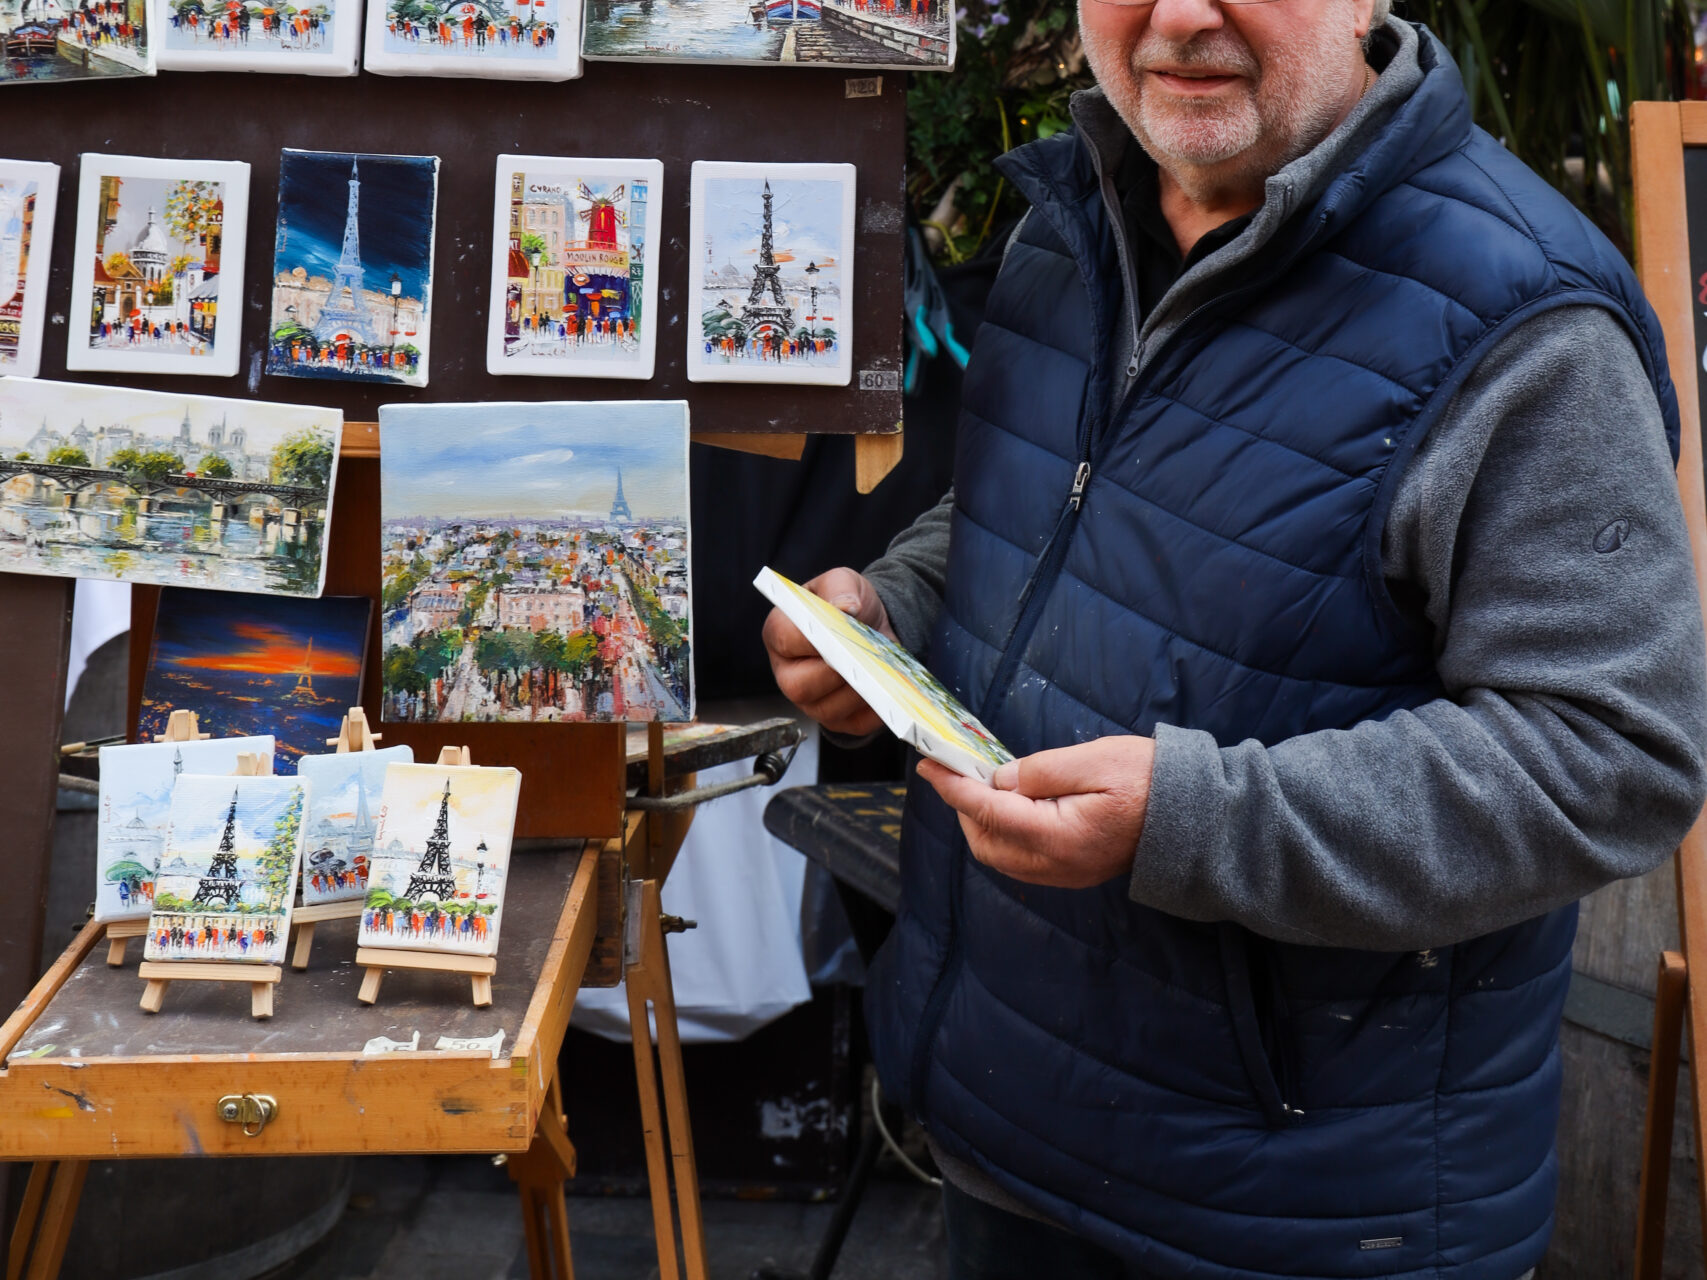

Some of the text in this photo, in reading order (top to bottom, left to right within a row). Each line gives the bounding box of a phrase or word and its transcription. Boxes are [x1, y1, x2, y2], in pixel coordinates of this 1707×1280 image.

[567, 251, 625, 265] MOULIN ROUGE
[864, 373, 883, 388] 60
